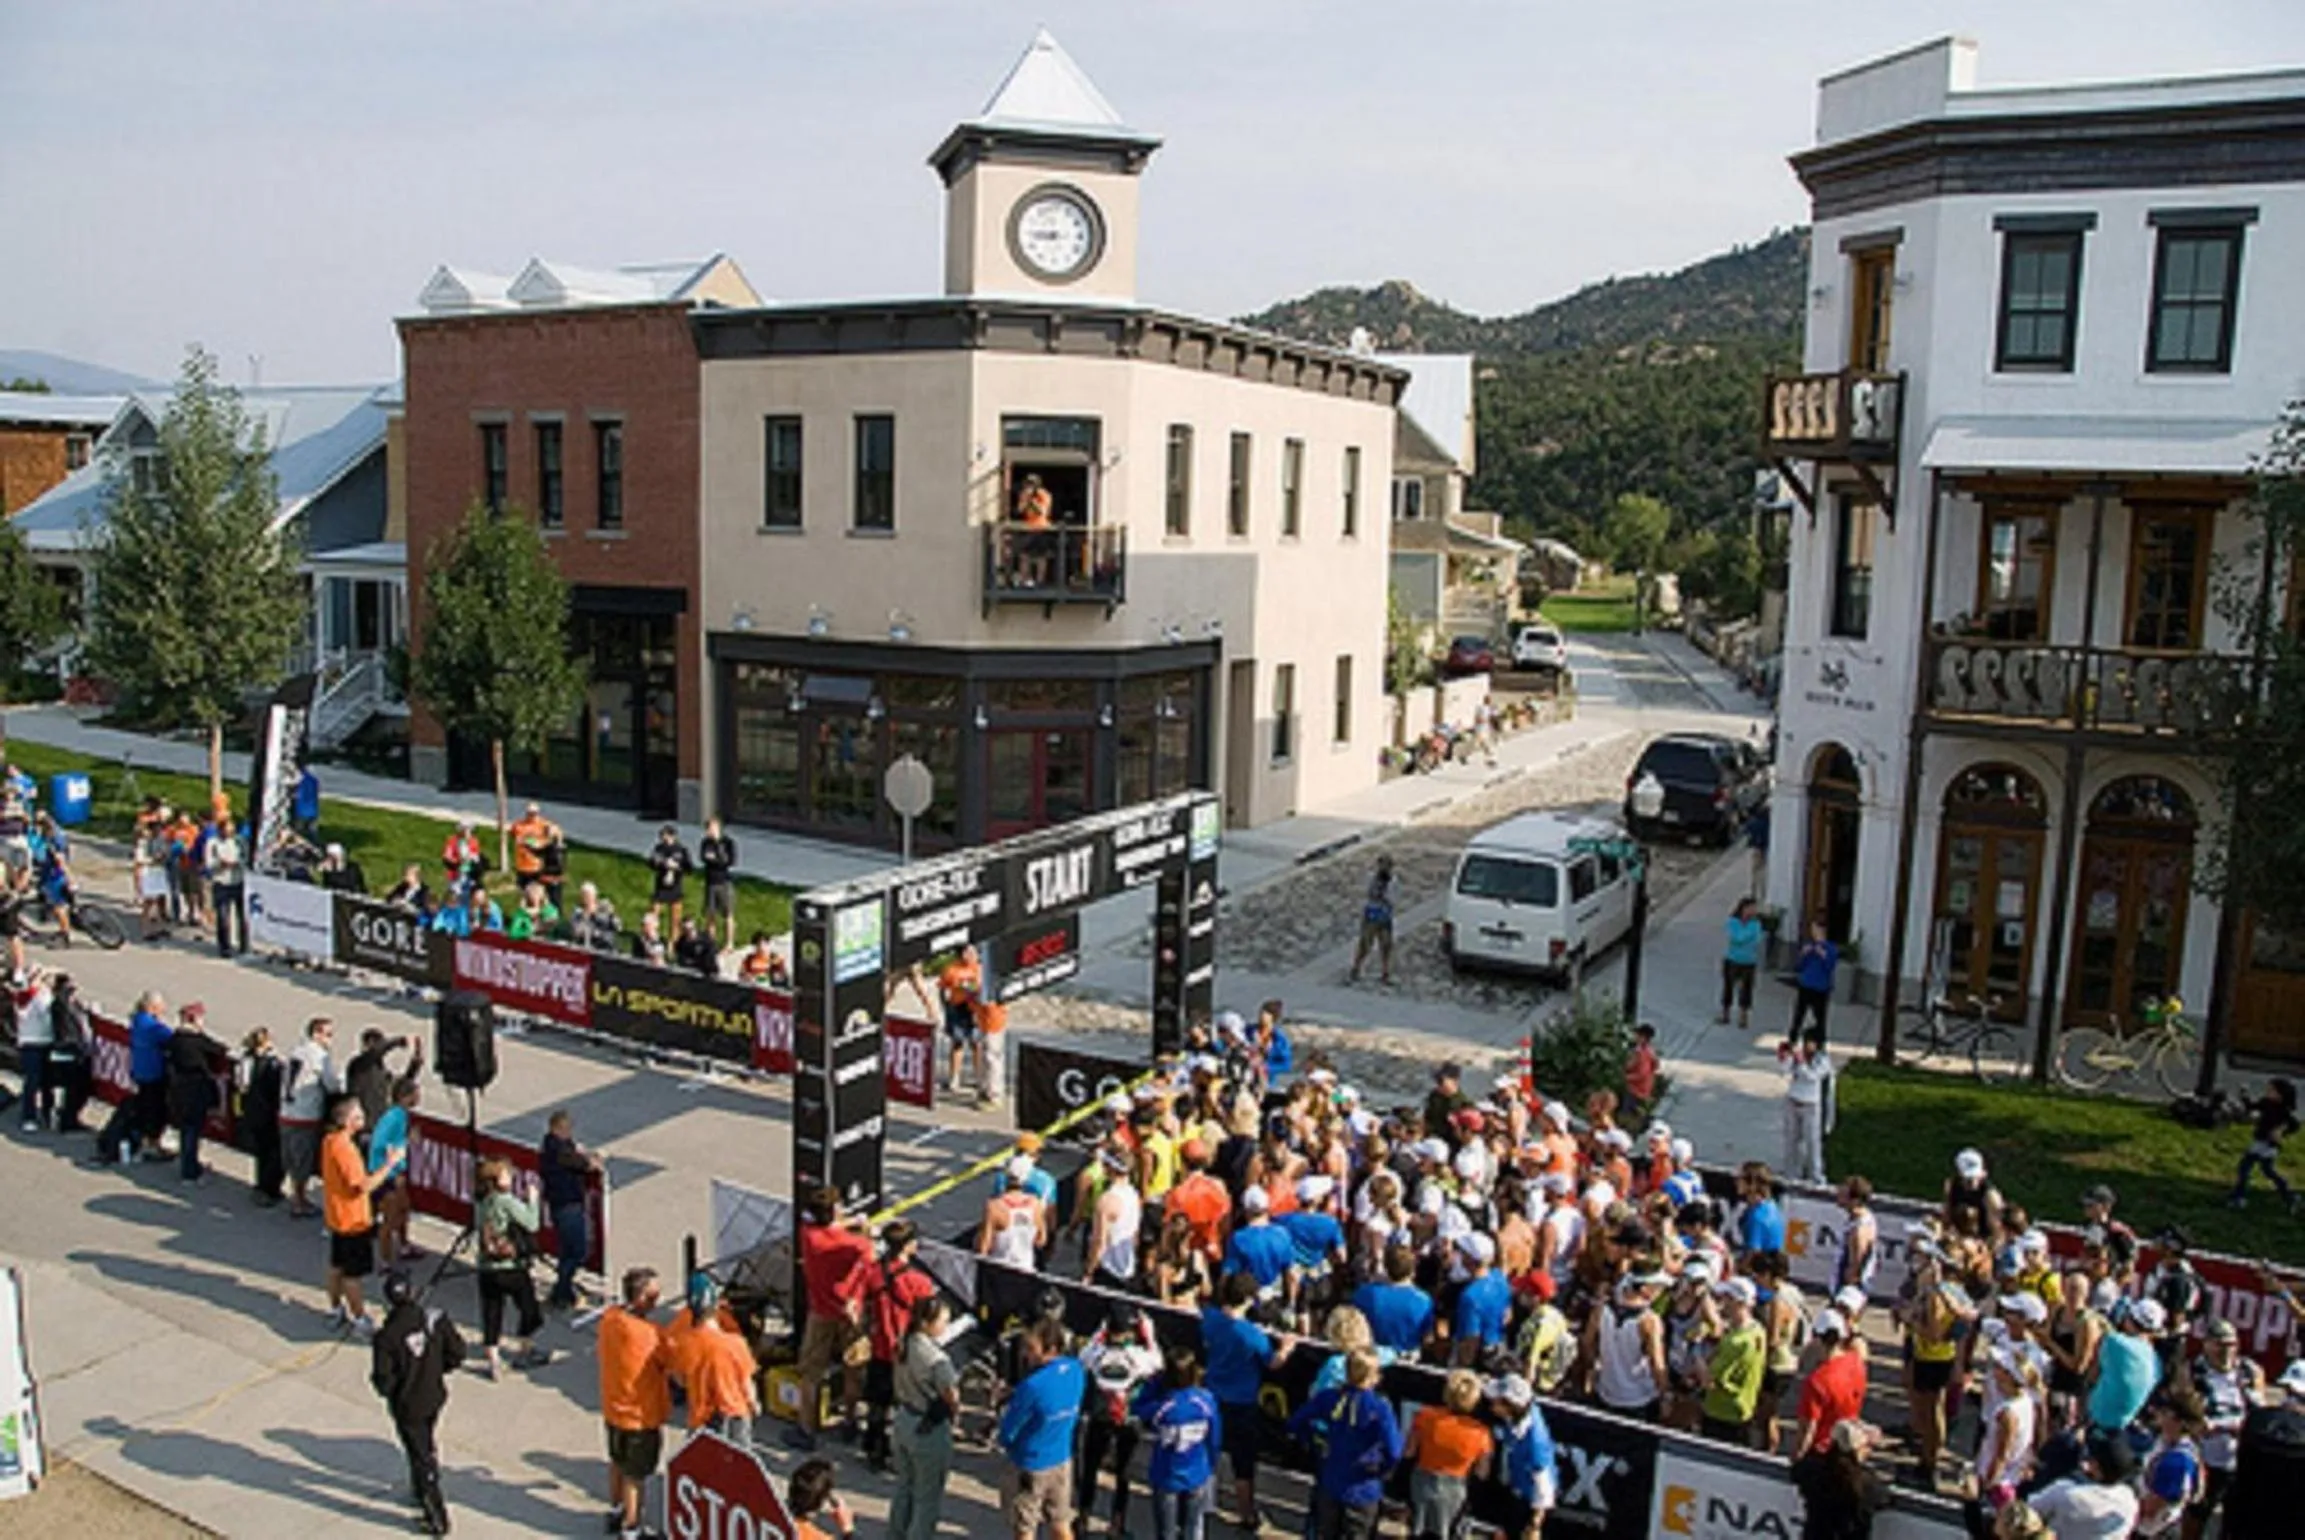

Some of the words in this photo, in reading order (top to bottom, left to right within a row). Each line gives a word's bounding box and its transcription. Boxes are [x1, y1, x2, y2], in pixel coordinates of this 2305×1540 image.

[1026, 844, 1094, 914] START
[350, 911, 429, 956] GORE
[674, 1474, 786, 1540] STOP
